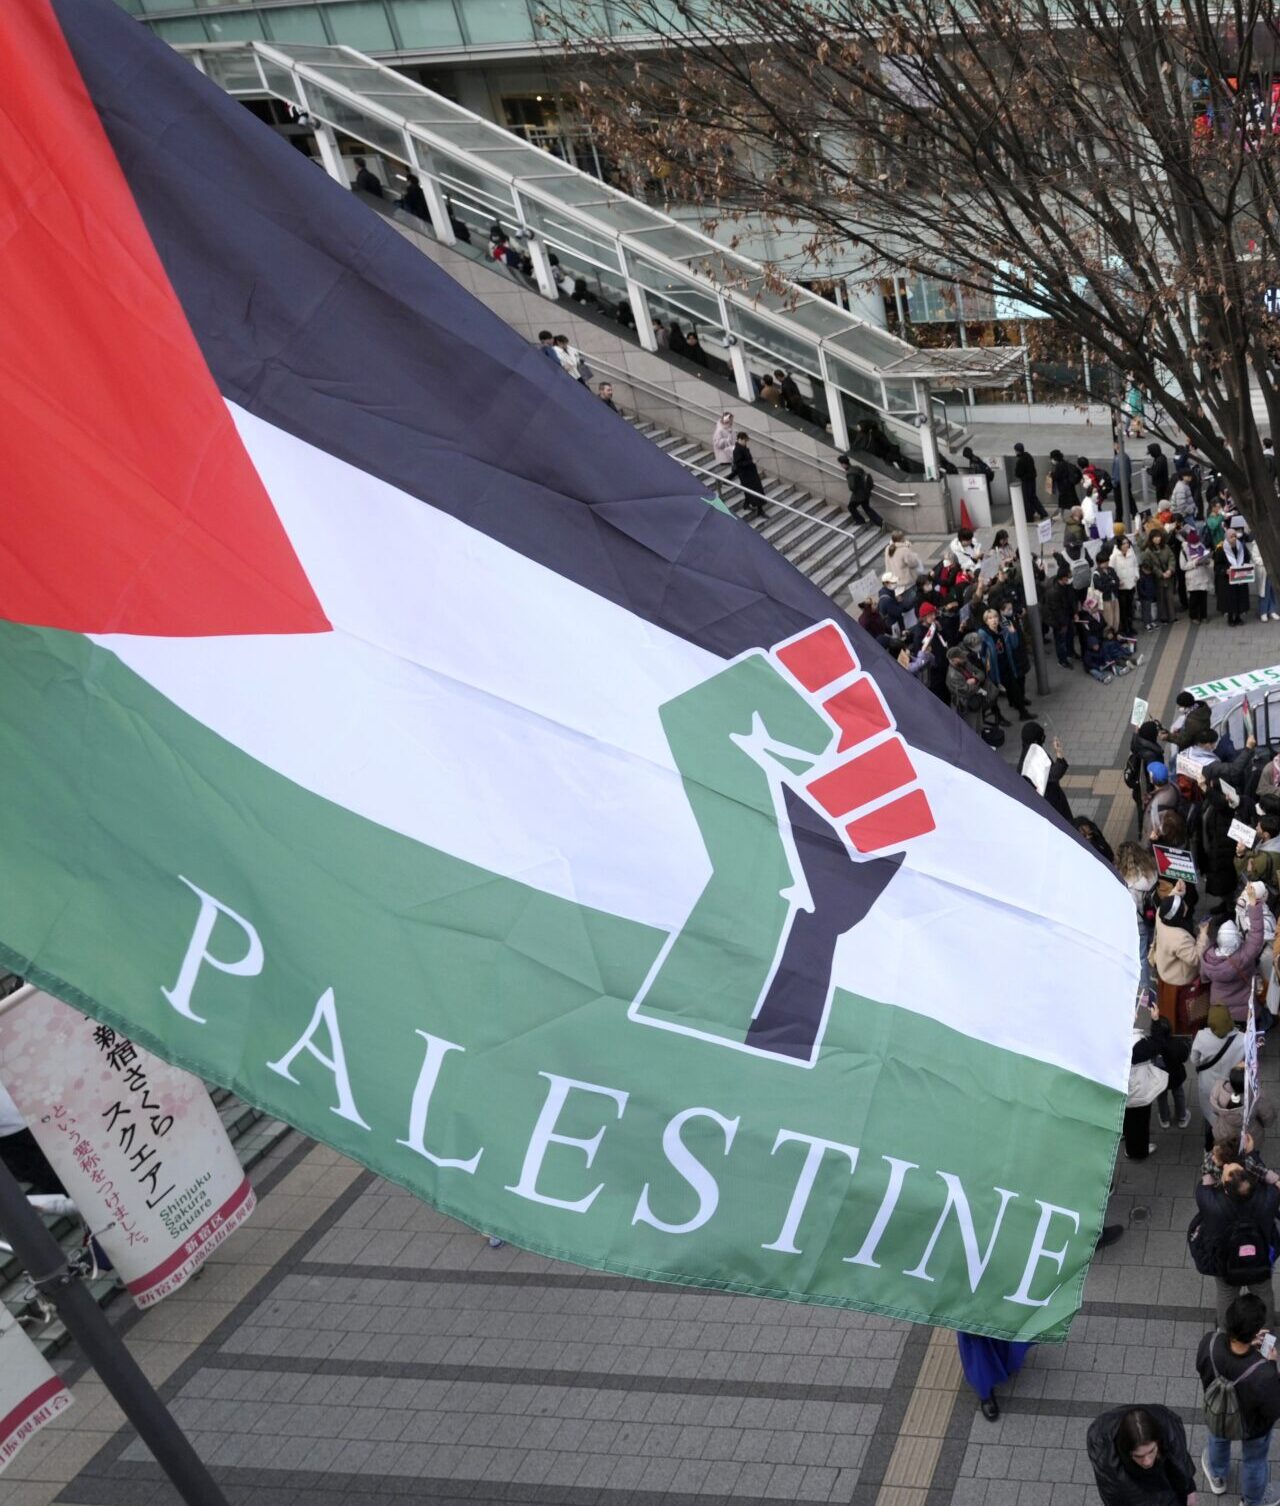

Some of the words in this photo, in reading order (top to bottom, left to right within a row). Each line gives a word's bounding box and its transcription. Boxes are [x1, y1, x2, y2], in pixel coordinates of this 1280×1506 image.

[160, 875, 1079, 1308] PALESTINE
[160, 1171, 212, 1222] Shinjuku
[165, 1189, 207, 1231] Sakura
[170, 1198, 212, 1239] Square
